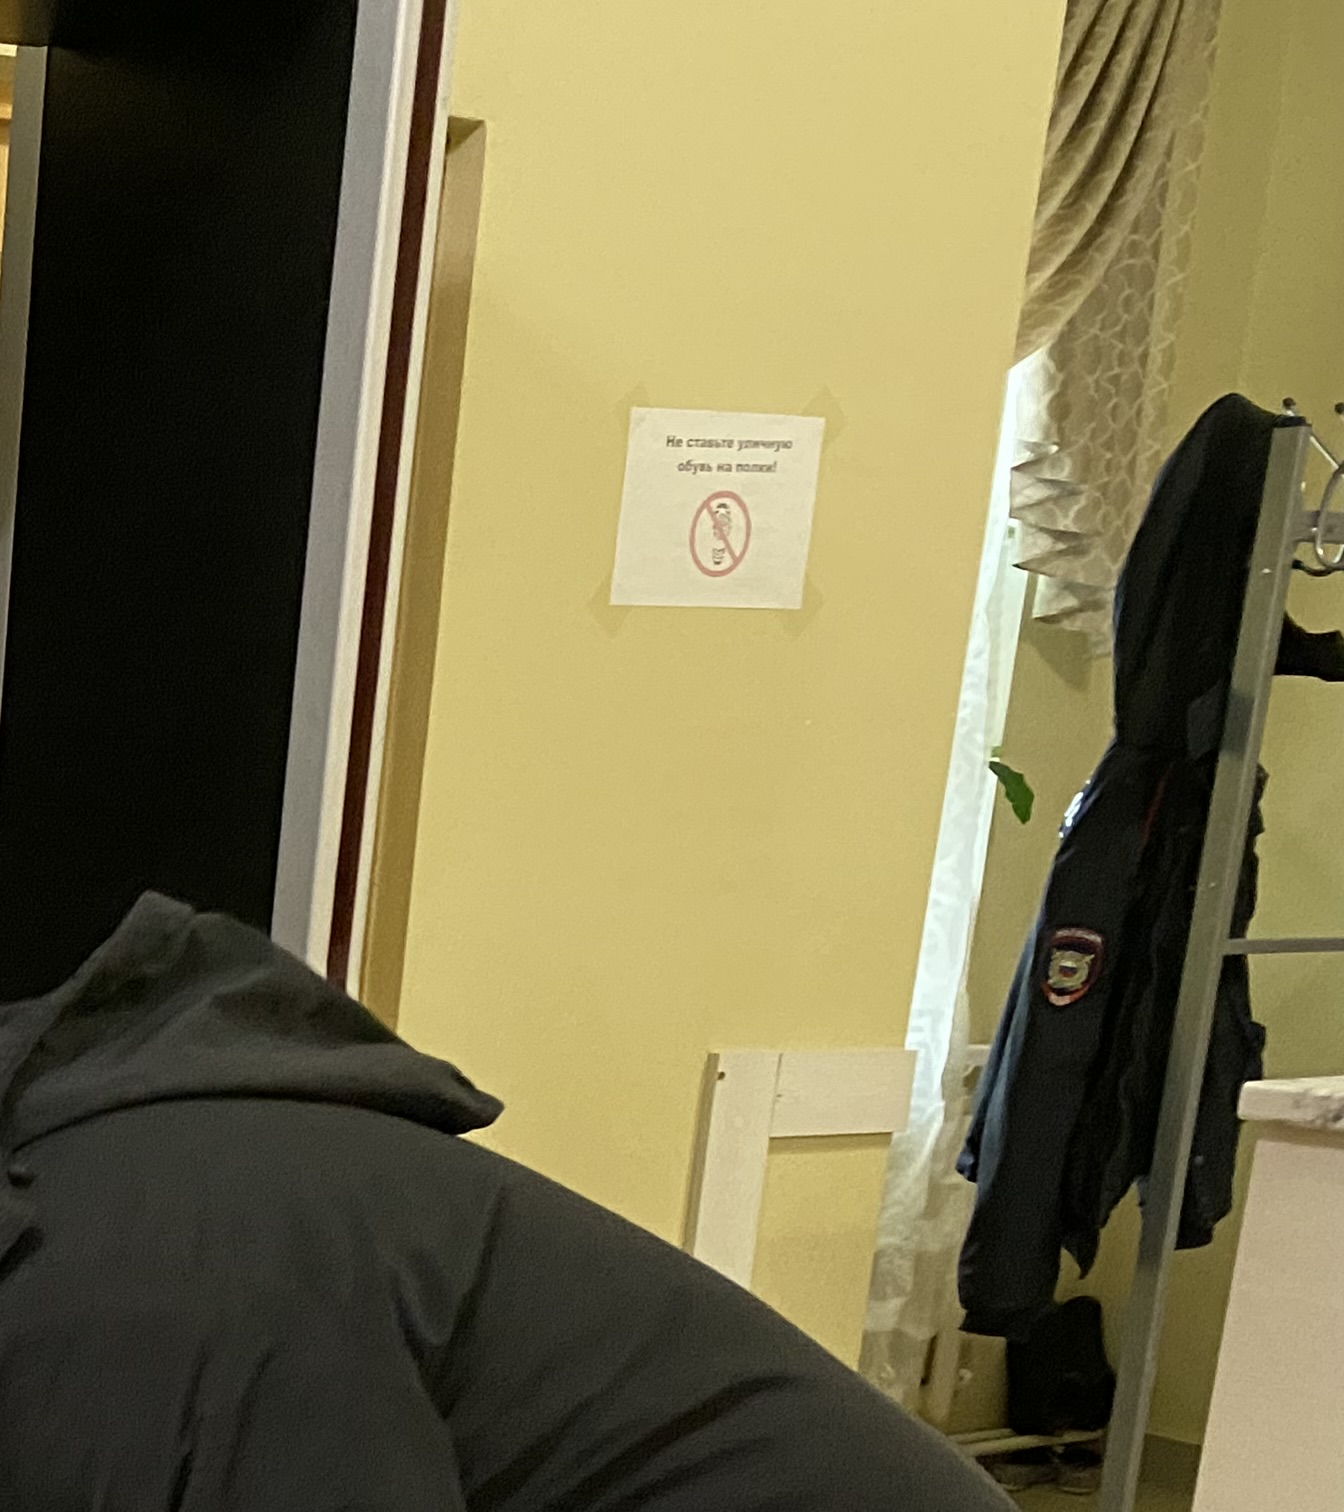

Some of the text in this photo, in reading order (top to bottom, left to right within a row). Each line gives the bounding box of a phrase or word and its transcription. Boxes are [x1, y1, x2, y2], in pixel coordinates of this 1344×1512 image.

[666, 434, 683, 448] Не
[686, 436, 734, 449] ставьте
[677, 459, 713, 475] обувь
[716, 462, 733, 473] на
